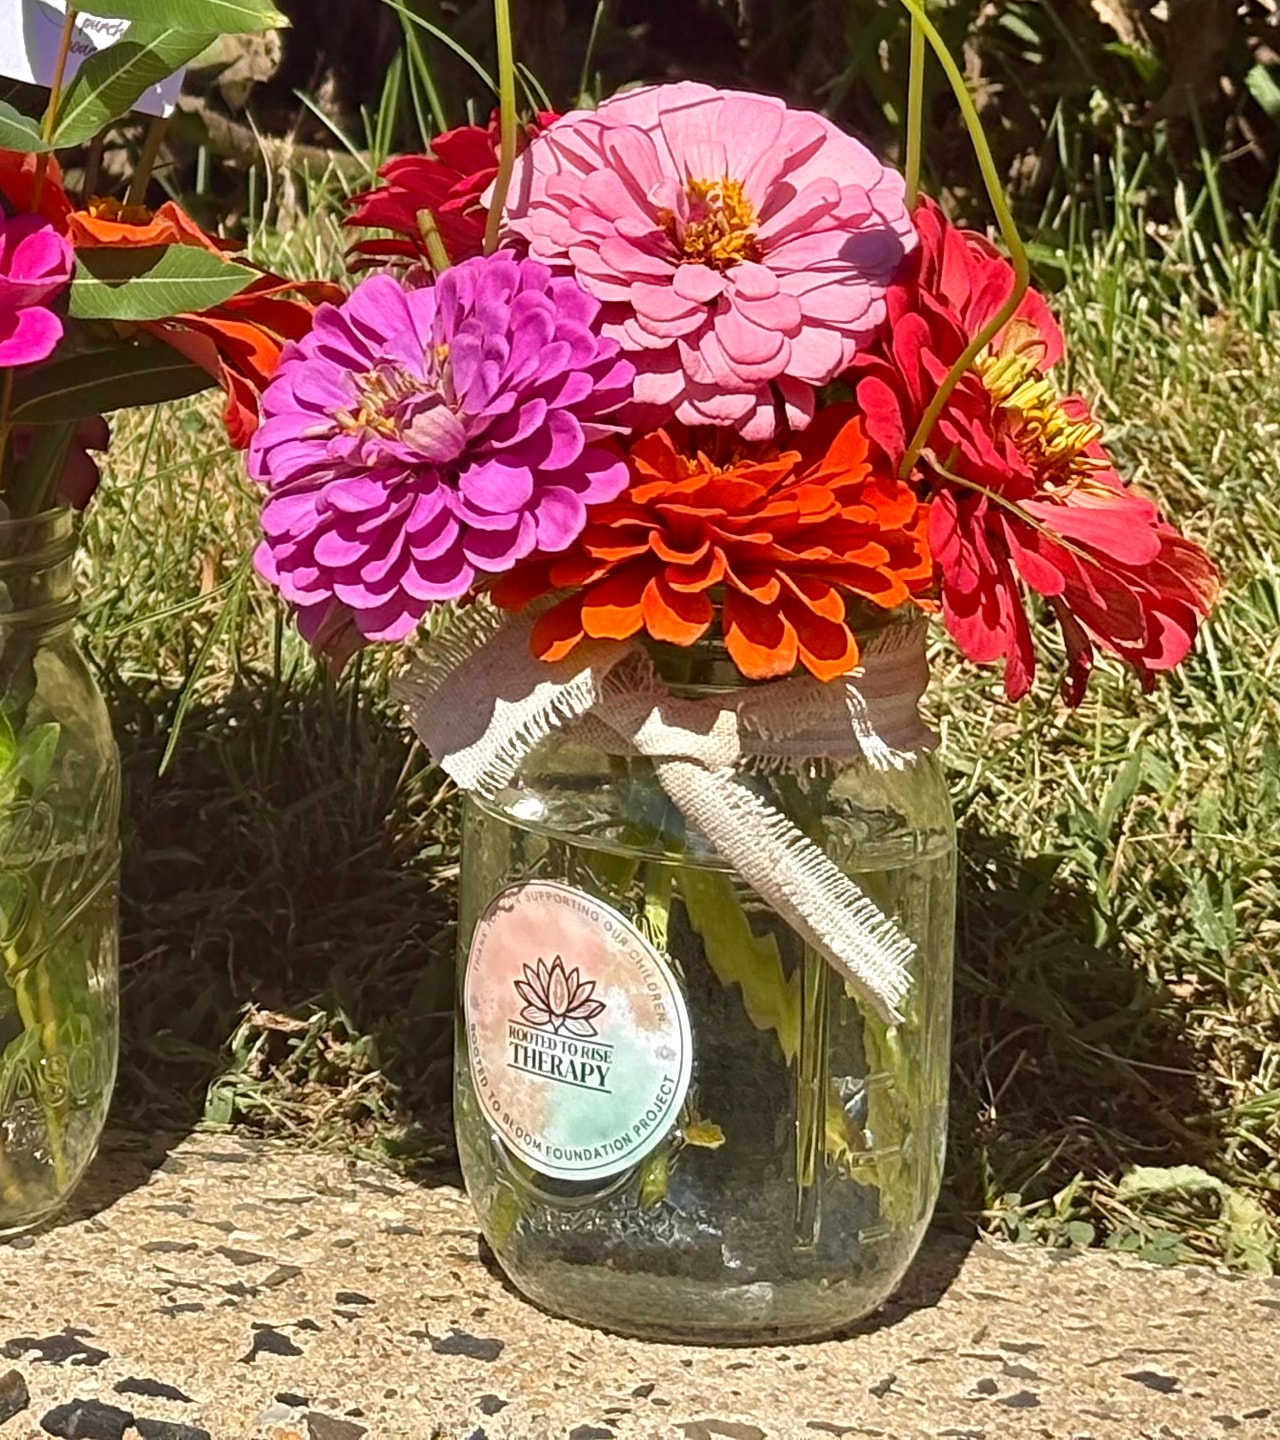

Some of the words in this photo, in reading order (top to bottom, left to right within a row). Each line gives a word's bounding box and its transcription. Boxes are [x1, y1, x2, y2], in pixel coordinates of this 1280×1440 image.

[523, 888, 600, 923] SUPPORTING
[602, 919, 629, 949] OUR
[628, 948, 668, 1024] CHILDREN
[507, 1041, 612, 1089] THERAPY
[508, 1023, 558, 1053] ROOTED
[557, 1037, 579, 1058] TO
[580, 1044, 614, 1066] RISE
[470, 1021, 489, 1090] ROOTED
[488, 1090, 502, 1114] TO
[502, 1111, 543, 1155] BLOOM
[544, 1132, 634, 1163] FOUNDATION
[633, 1073, 677, 1139] PROJECT
